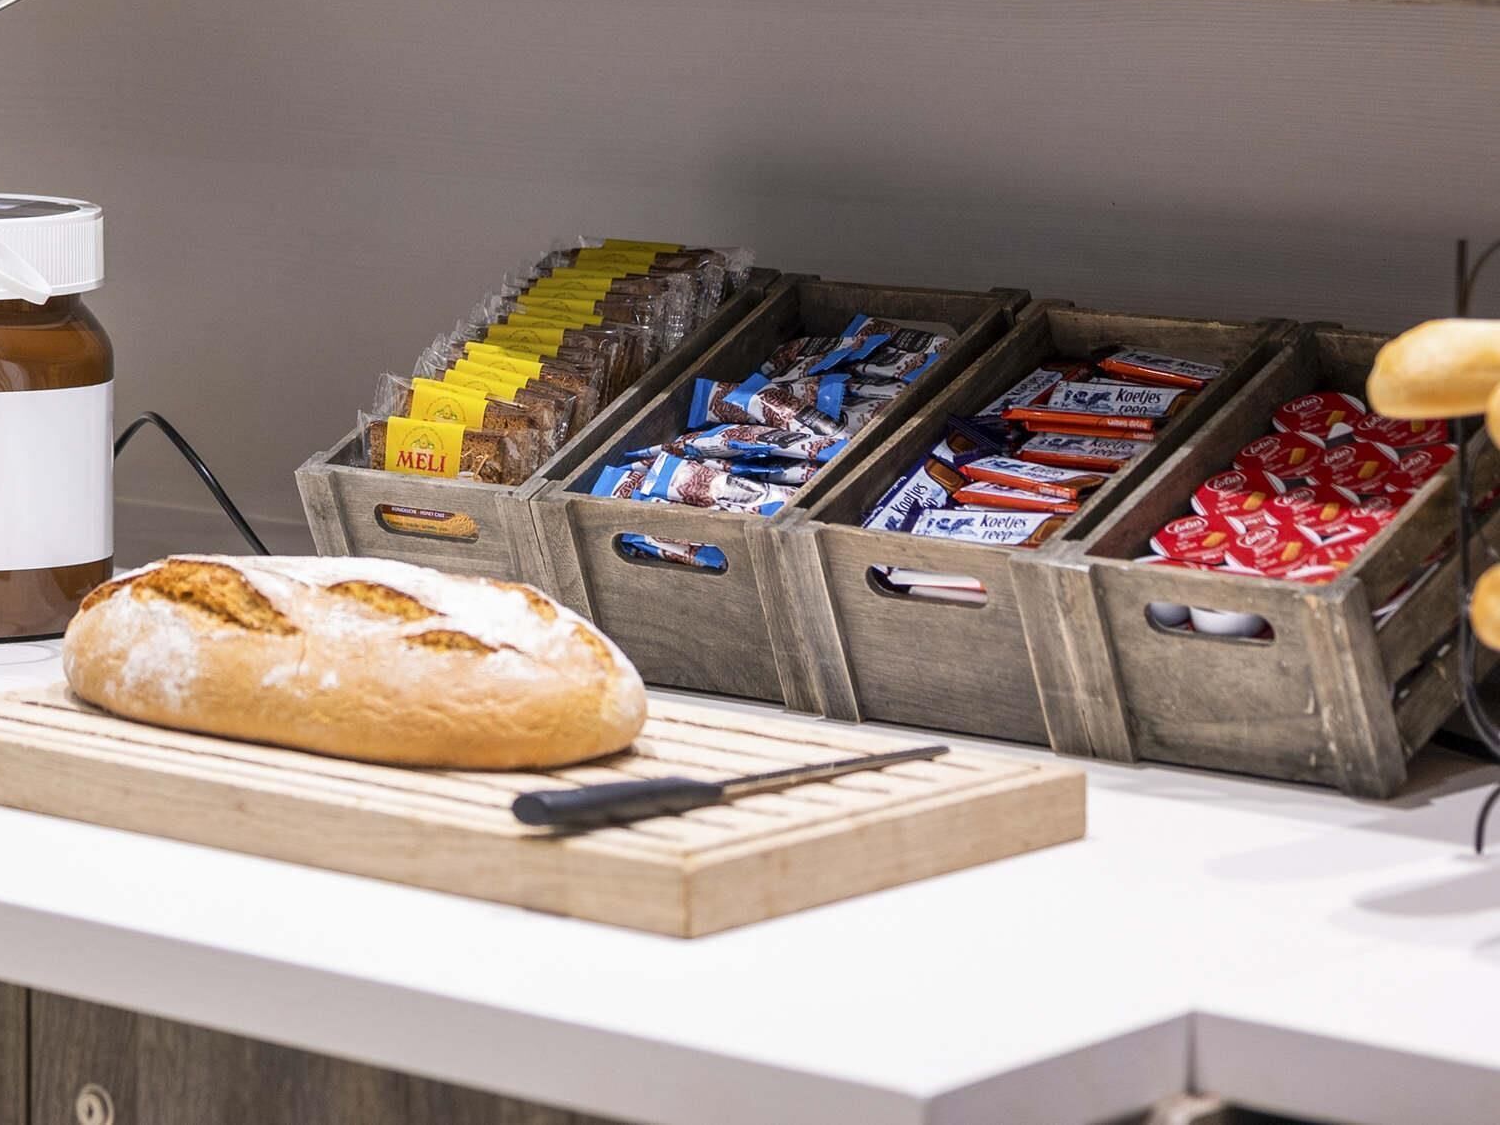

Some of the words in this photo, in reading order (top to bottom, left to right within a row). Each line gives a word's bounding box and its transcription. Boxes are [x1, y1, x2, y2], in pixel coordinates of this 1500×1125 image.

[1115, 387, 1162, 404] Koetjes
[396, 450, 447, 473] MELI
[980, 514, 1029, 529] Koetjes
[982, 530, 1013, 543] reep
